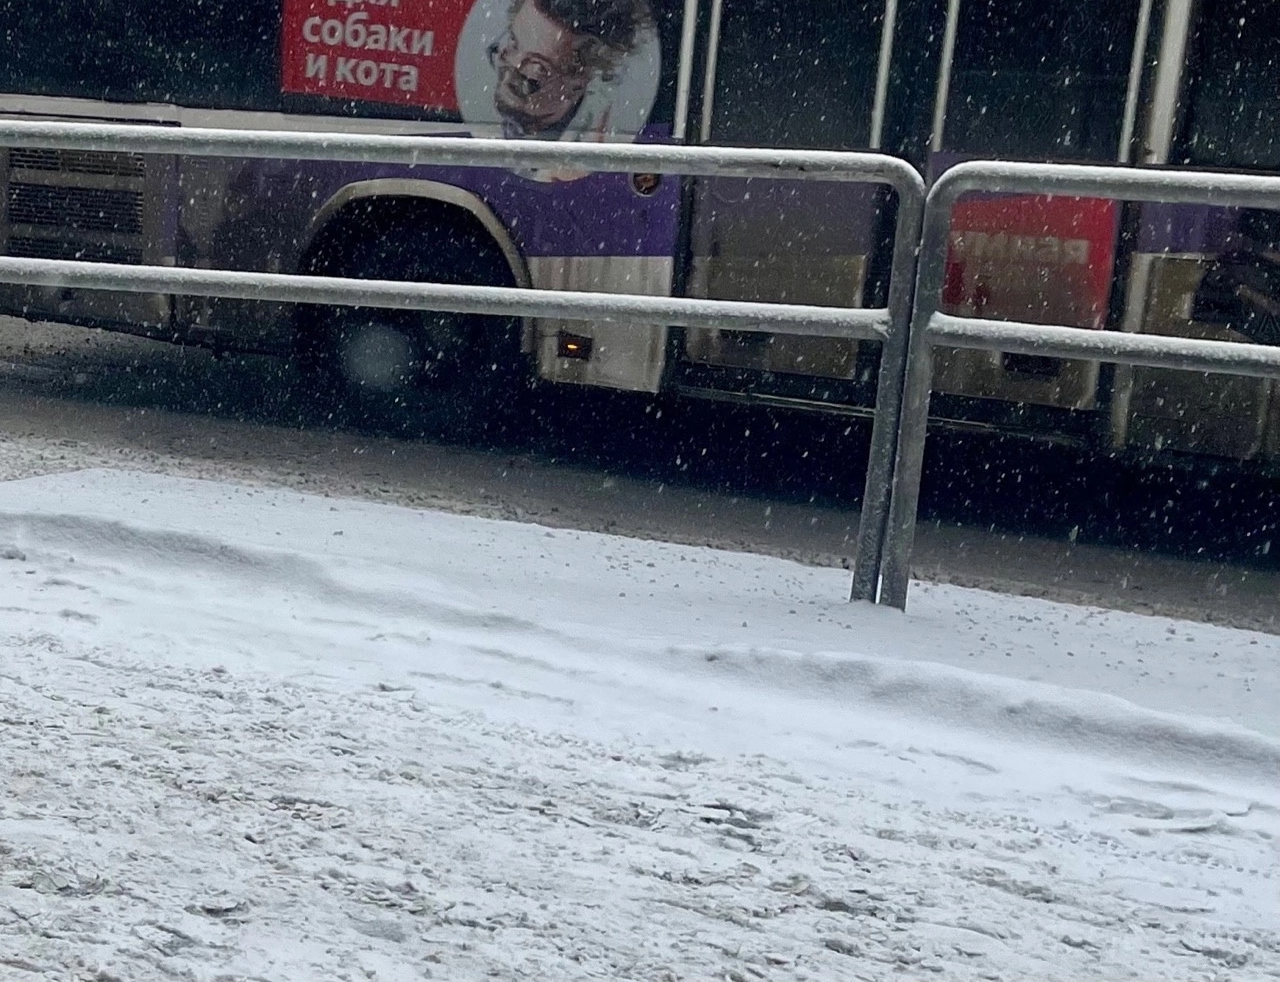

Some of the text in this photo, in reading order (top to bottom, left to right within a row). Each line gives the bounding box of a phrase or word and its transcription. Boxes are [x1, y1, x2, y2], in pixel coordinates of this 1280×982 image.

[303, 11, 434, 57] собаки
[305, 53, 420, 93] и кота
